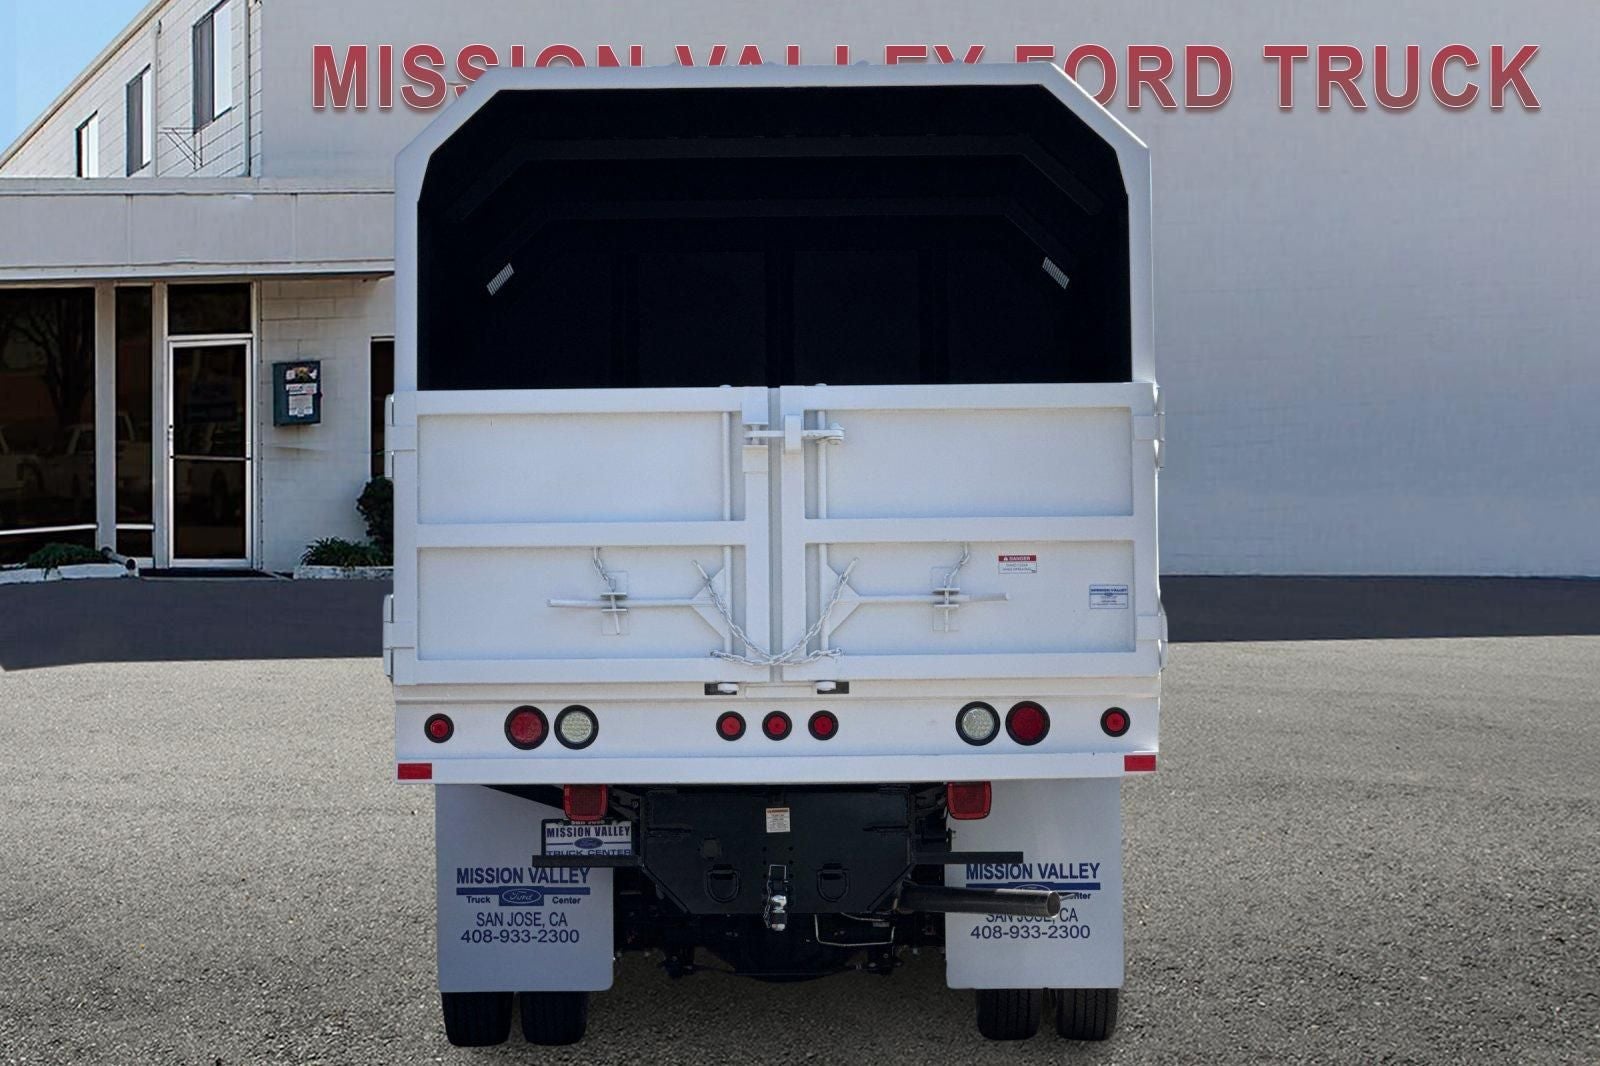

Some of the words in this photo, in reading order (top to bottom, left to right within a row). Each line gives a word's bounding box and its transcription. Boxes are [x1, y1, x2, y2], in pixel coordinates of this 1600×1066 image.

[1015, 44, 1233, 107] ORD
[1263, 44, 1541, 108] TRUCK
[546, 826, 591, 838] MISSION
[594, 825, 631, 837] VALLEY
[456, 867, 524, 884] MISSION
[528, 867, 591, 884] VALLEY
[965, 863, 1033, 880] MISSION
[1037, 862, 1100, 880] VALLEY
[466, 895, 491, 904] Truck
[552, 896, 581, 905] Center
[476, 911, 504, 927] SAN
[507, 911, 546, 928] JOSE,
[549, 911, 568, 927] CA
[1059, 907, 1079, 923] CA
[460, 929, 580, 944] 408-933-2300
[970, 924, 1091, 940] 408-933-2300
